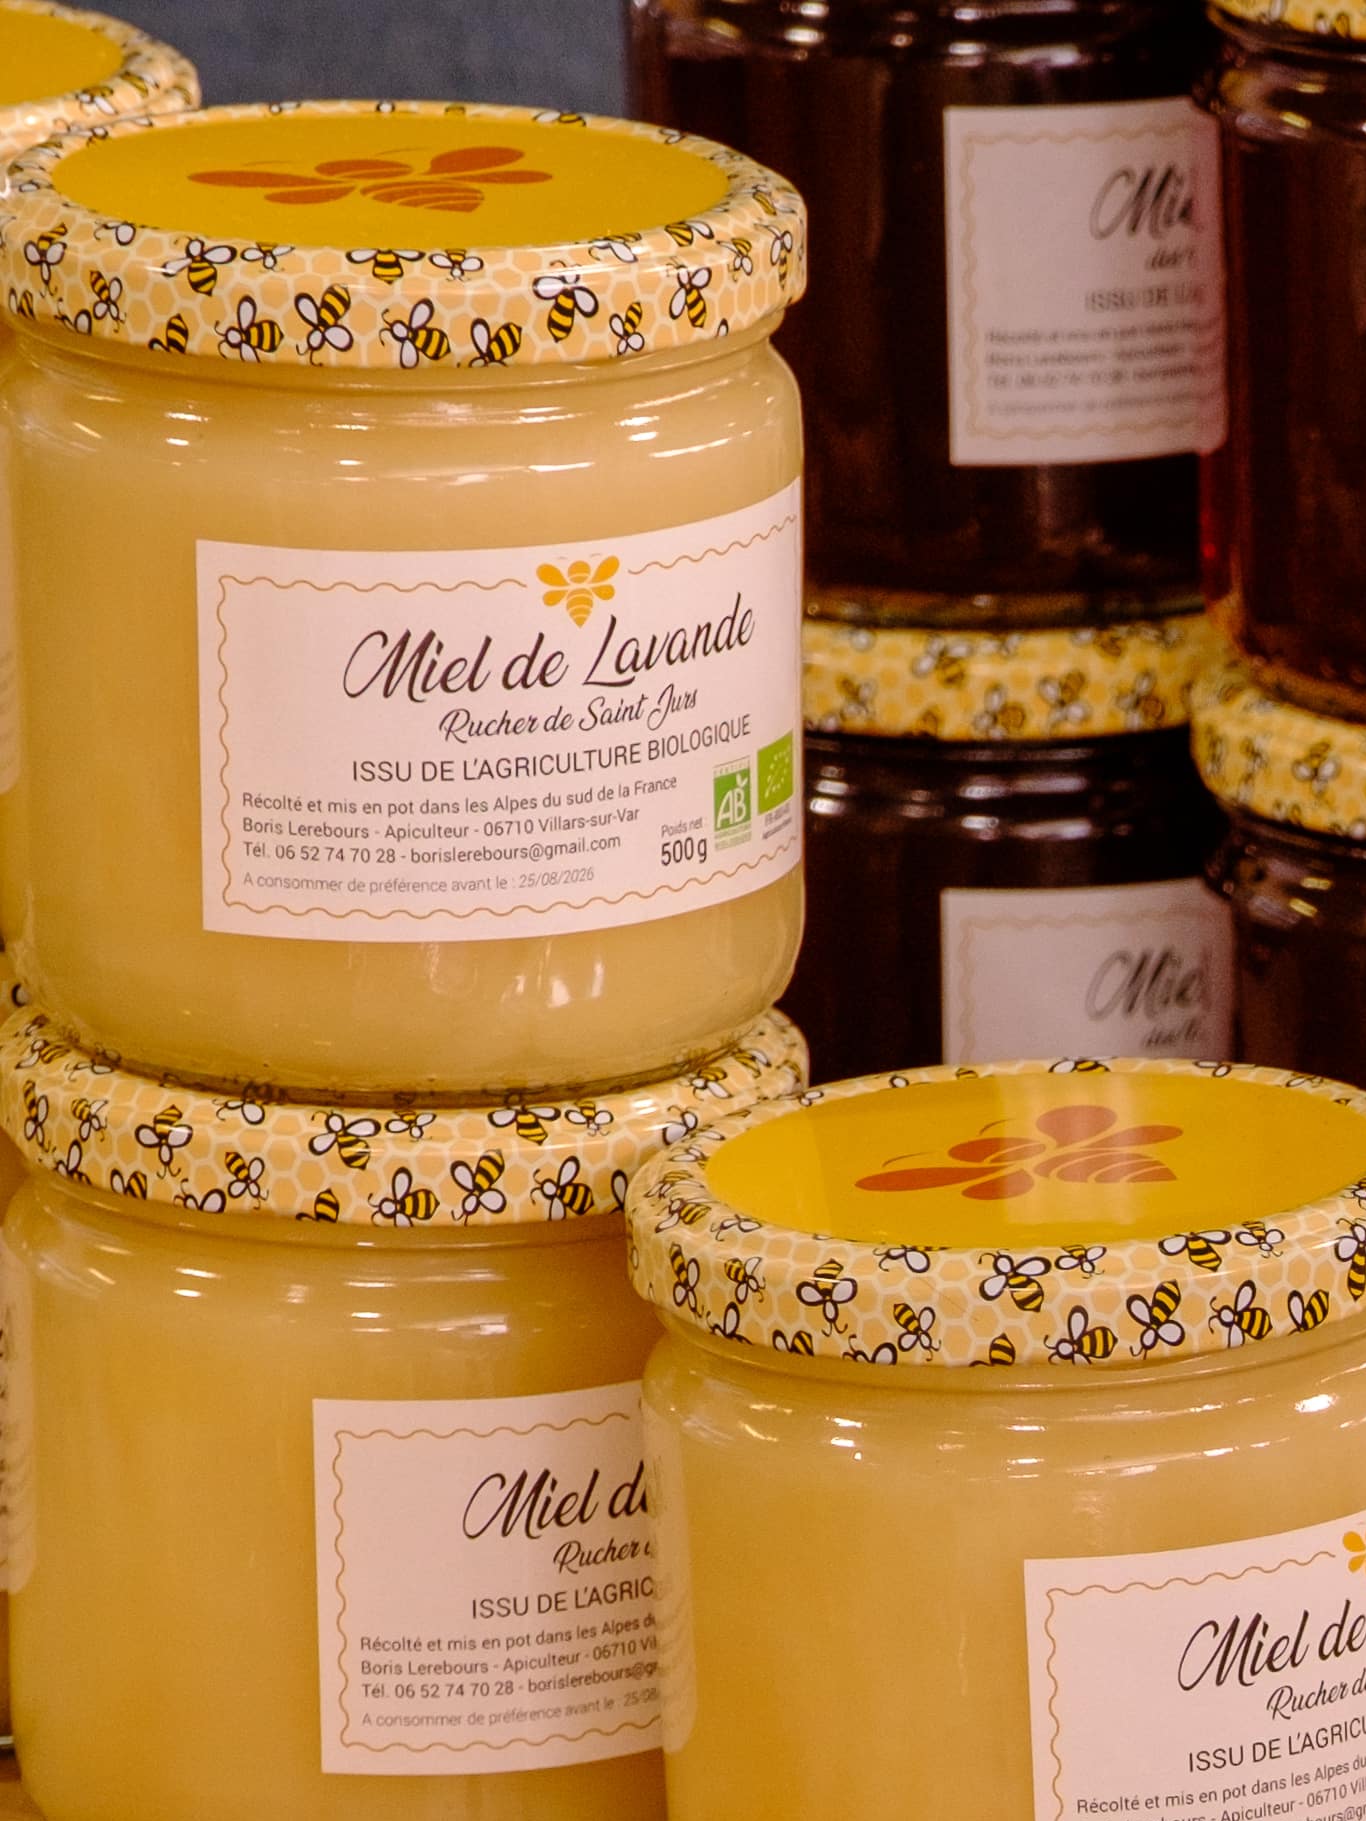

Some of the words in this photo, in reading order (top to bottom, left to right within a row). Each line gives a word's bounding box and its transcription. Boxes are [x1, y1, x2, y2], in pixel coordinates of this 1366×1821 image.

[342, 628, 493, 704] Miel
[501, 631, 569, 691] de
[581, 591, 753, 688] Lavande
[438, 708, 539, 745] Rucher
[543, 705, 575, 733] de
[578, 693, 649, 732] Saint
[646, 683, 698, 732] Jurs
[352, 760, 412, 783] ISSU
[421, 760, 455, 782] DE
[463, 742, 643, 784] L'AGRICULTURE
[646, 712, 751, 761] BIOLOGIQUE
[242, 791, 303, 812] Récolté
[306, 799, 323, 814] et
[327, 801, 358, 815] mis
[361, 802, 383, 815] en
[387, 801, 415, 819] pot
[419, 799, 460, 815] dans
[465, 797, 489, 814] les
[492, 794, 538, 815] Alpes
[541, 791, 562, 809] du
[566, 787, 593, 806] sud
[596, 785, 615, 802] de
[618, 783, 631, 799] la
[633, 776, 678, 796] France
[242, 816, 284, 836] Boris
[288, 820, 370, 839] Lerebours
[384, 823, 470, 842] Apiculteur
[483, 818, 535, 837] 06710
[537, 807, 640, 833] Villars-sur-Var
[660, 820, 688, 838] Poids
[242, 840, 266, 858] Tél.
[275, 844, 296, 860] 06
[300, 845, 320, 862] 52
[326, 846, 345, 862] 74
[349, 847, 371, 864] 70
[375, 847, 396, 864] 28
[410, 833, 621, 864] borislerebours@gmail.com
[242, 872, 254, 887] A
[256, 875, 343, 892] consommer
[346, 877, 367, 893] de
[369, 877, 448, 897] préférence
[450, 877, 492, 892] avant
[495, 875, 509, 891] le
[518, 866, 595, 889] 25/08/2026
[462, 1468, 600, 1540] Miel
[552, 1539, 641, 1575] Rucher
[472, 1596, 529, 1620] ISSU
[537, 1591, 568, 1614] DE
[1177, 1609, 1310, 1692] Miel
[1266, 1683, 1348, 1721] Rucher
[1188, 1747, 1244, 1773] ISSU
[1252, 1737, 1282, 1763] DE
